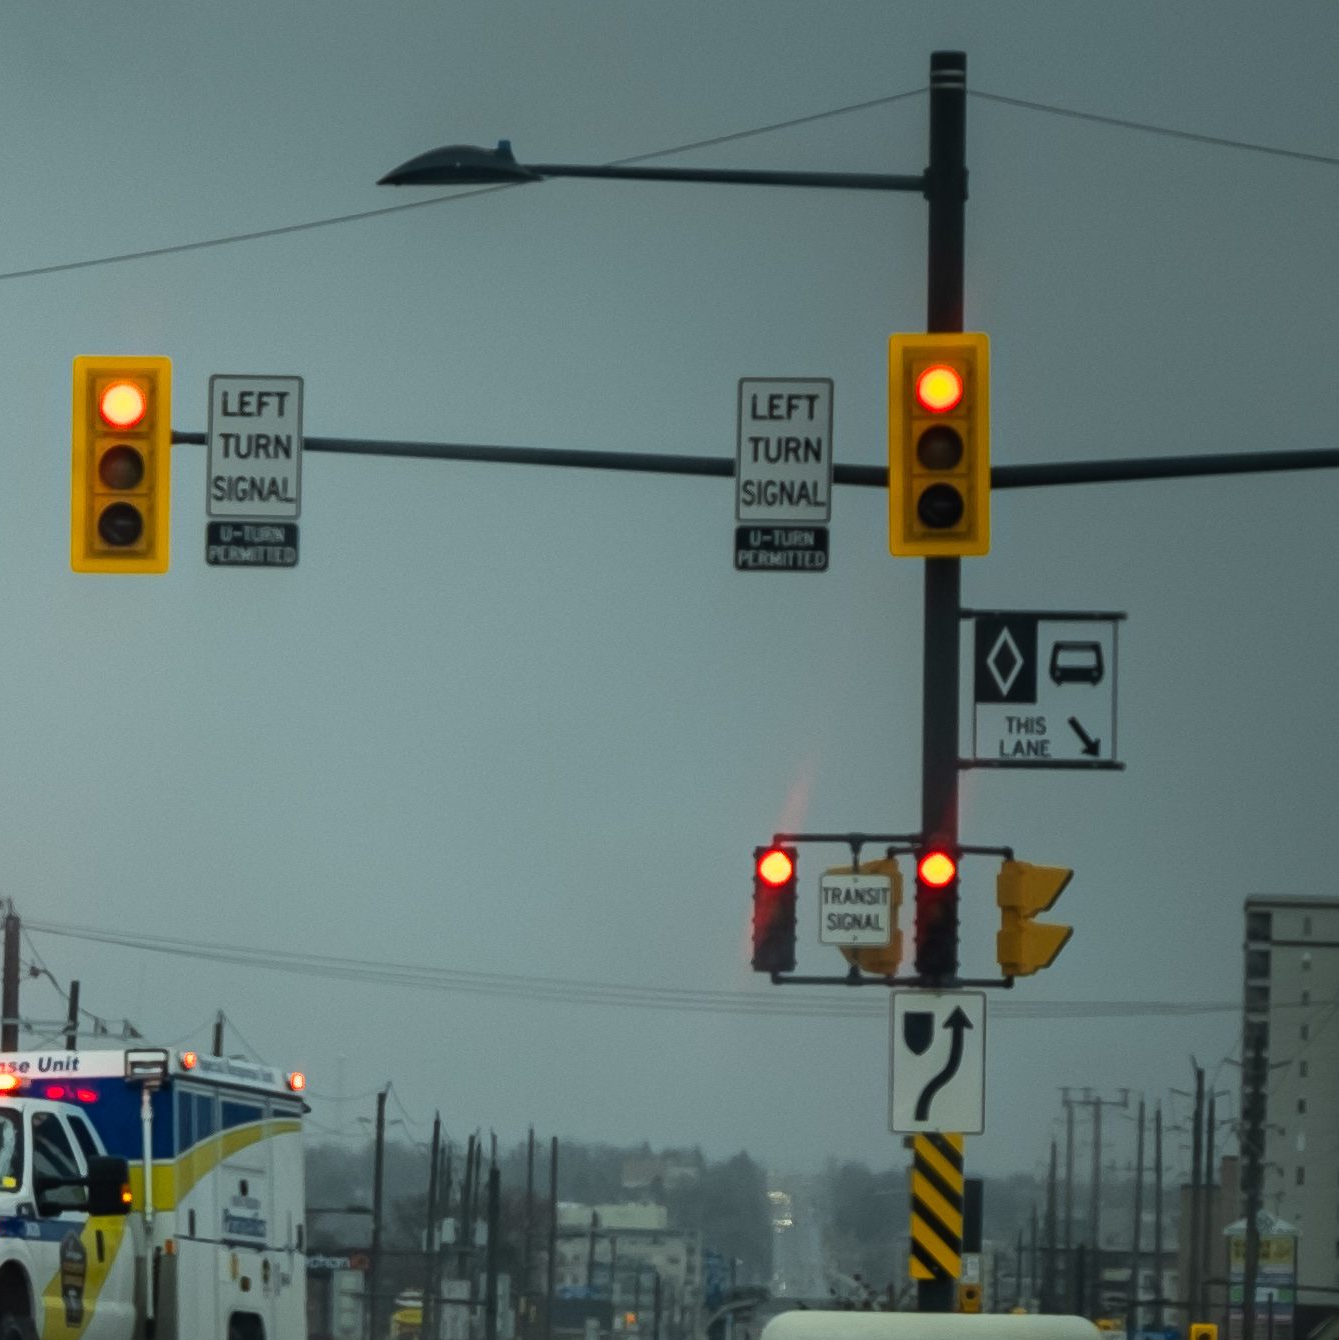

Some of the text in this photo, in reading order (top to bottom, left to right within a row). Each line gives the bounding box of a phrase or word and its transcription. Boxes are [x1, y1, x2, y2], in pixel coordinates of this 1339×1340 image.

[222, 390, 290, 418] LEFT
[750, 393, 820, 421] LEFT
[219, 433, 293, 460] TURN
[748, 436, 822, 465] TURN
[211, 475, 296, 504] SIGNAL
[741, 479, 827, 507] SIGNAL
[749, 530, 815, 547] U-TURN
[1005, 715, 1047, 735] THIS
[999, 739, 1052, 758] LANE
[822, 886, 890, 906] TRANSIT
[826, 911, 884, 932] SIGNAL
[37, 1055, 80, 1073] Unit
